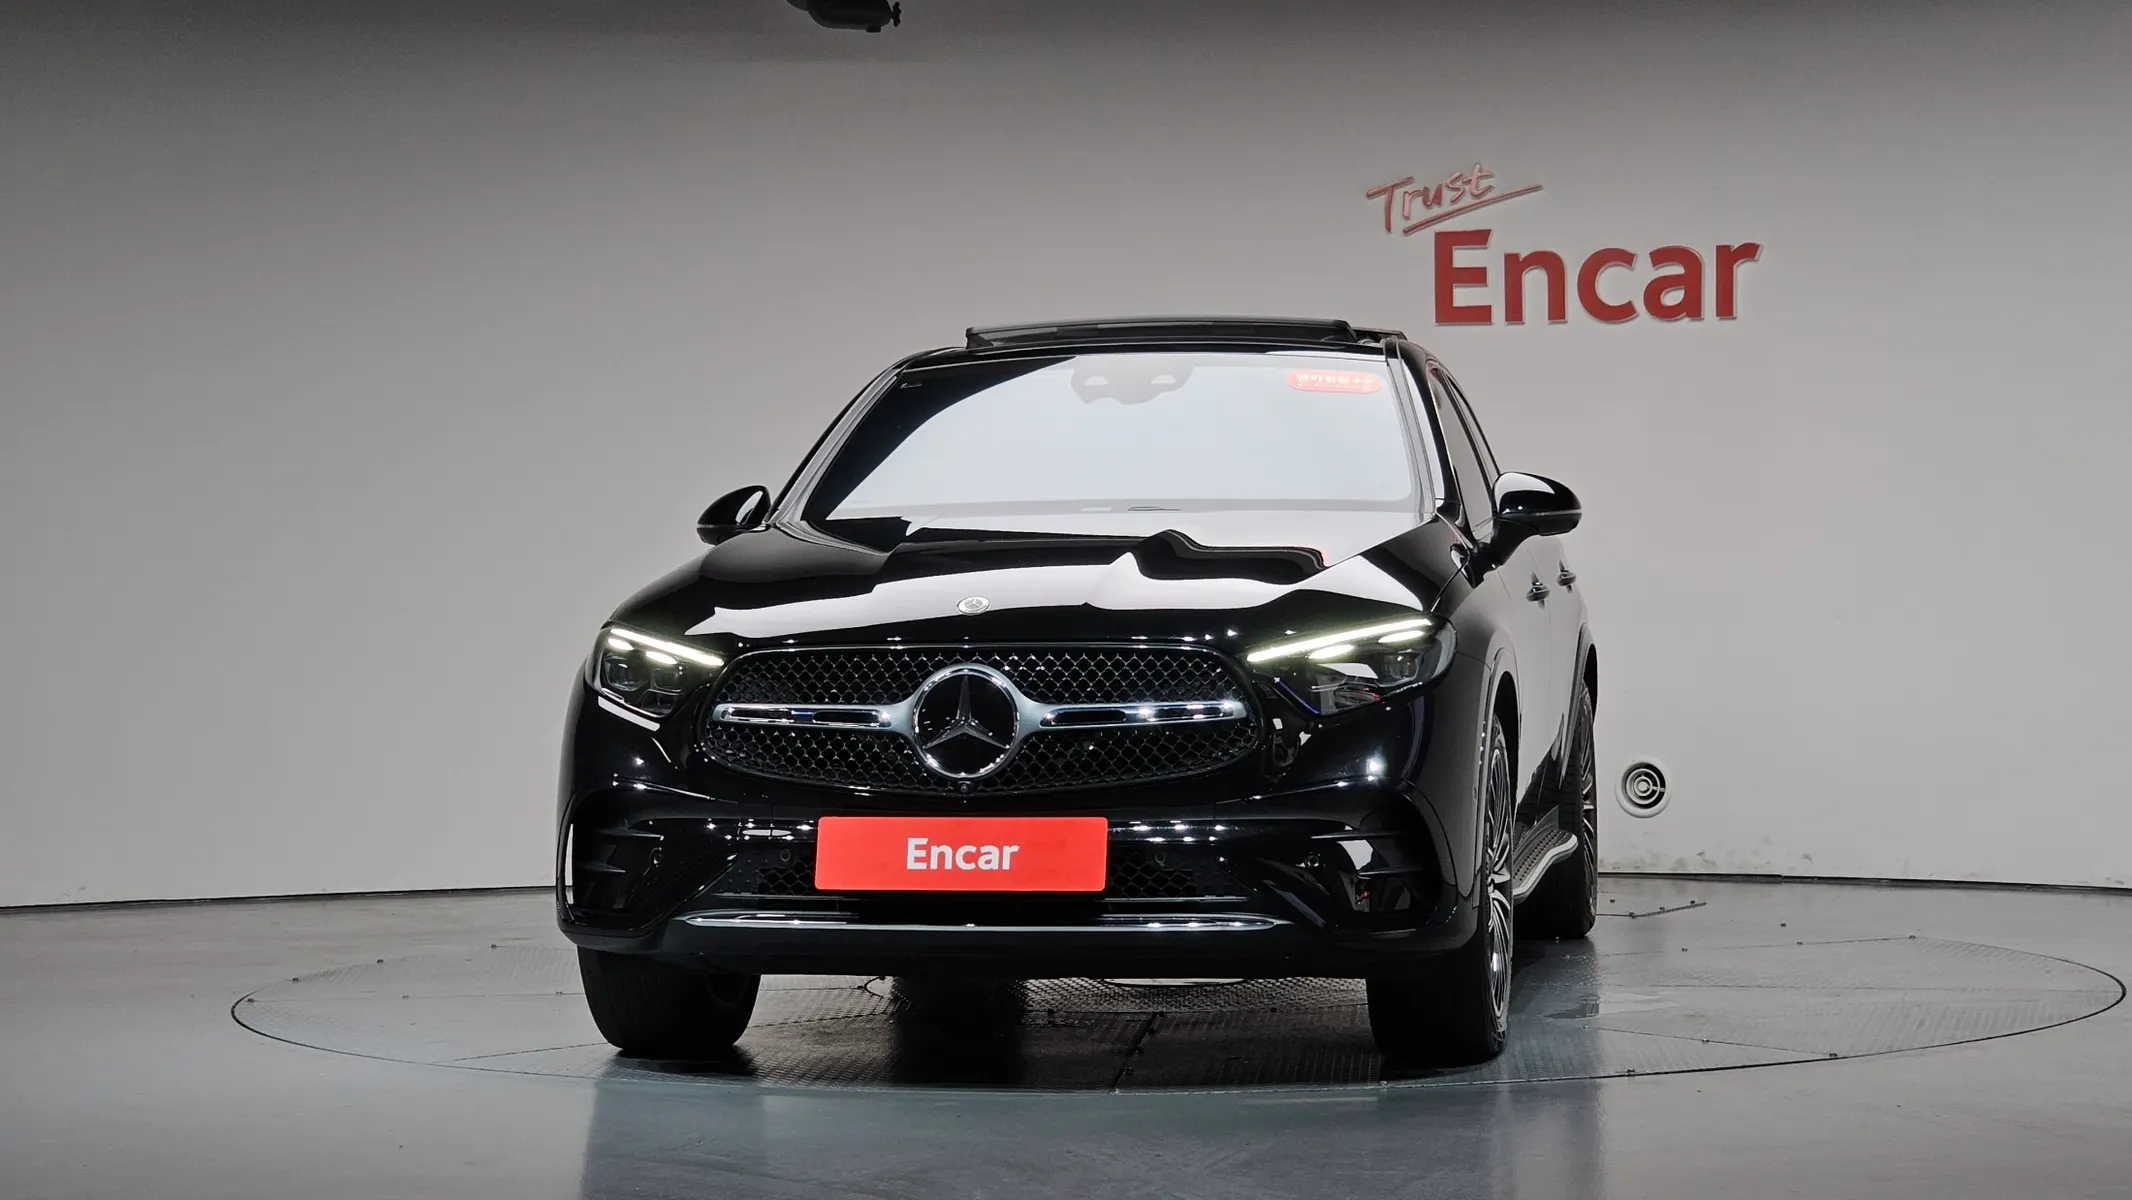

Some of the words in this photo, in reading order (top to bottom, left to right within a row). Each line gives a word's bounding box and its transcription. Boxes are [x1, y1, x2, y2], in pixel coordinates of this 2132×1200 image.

[1366, 162, 1496, 233] Trust
[1434, 228, 1761, 325] Encar
[906, 837, 1020, 871] Encar
